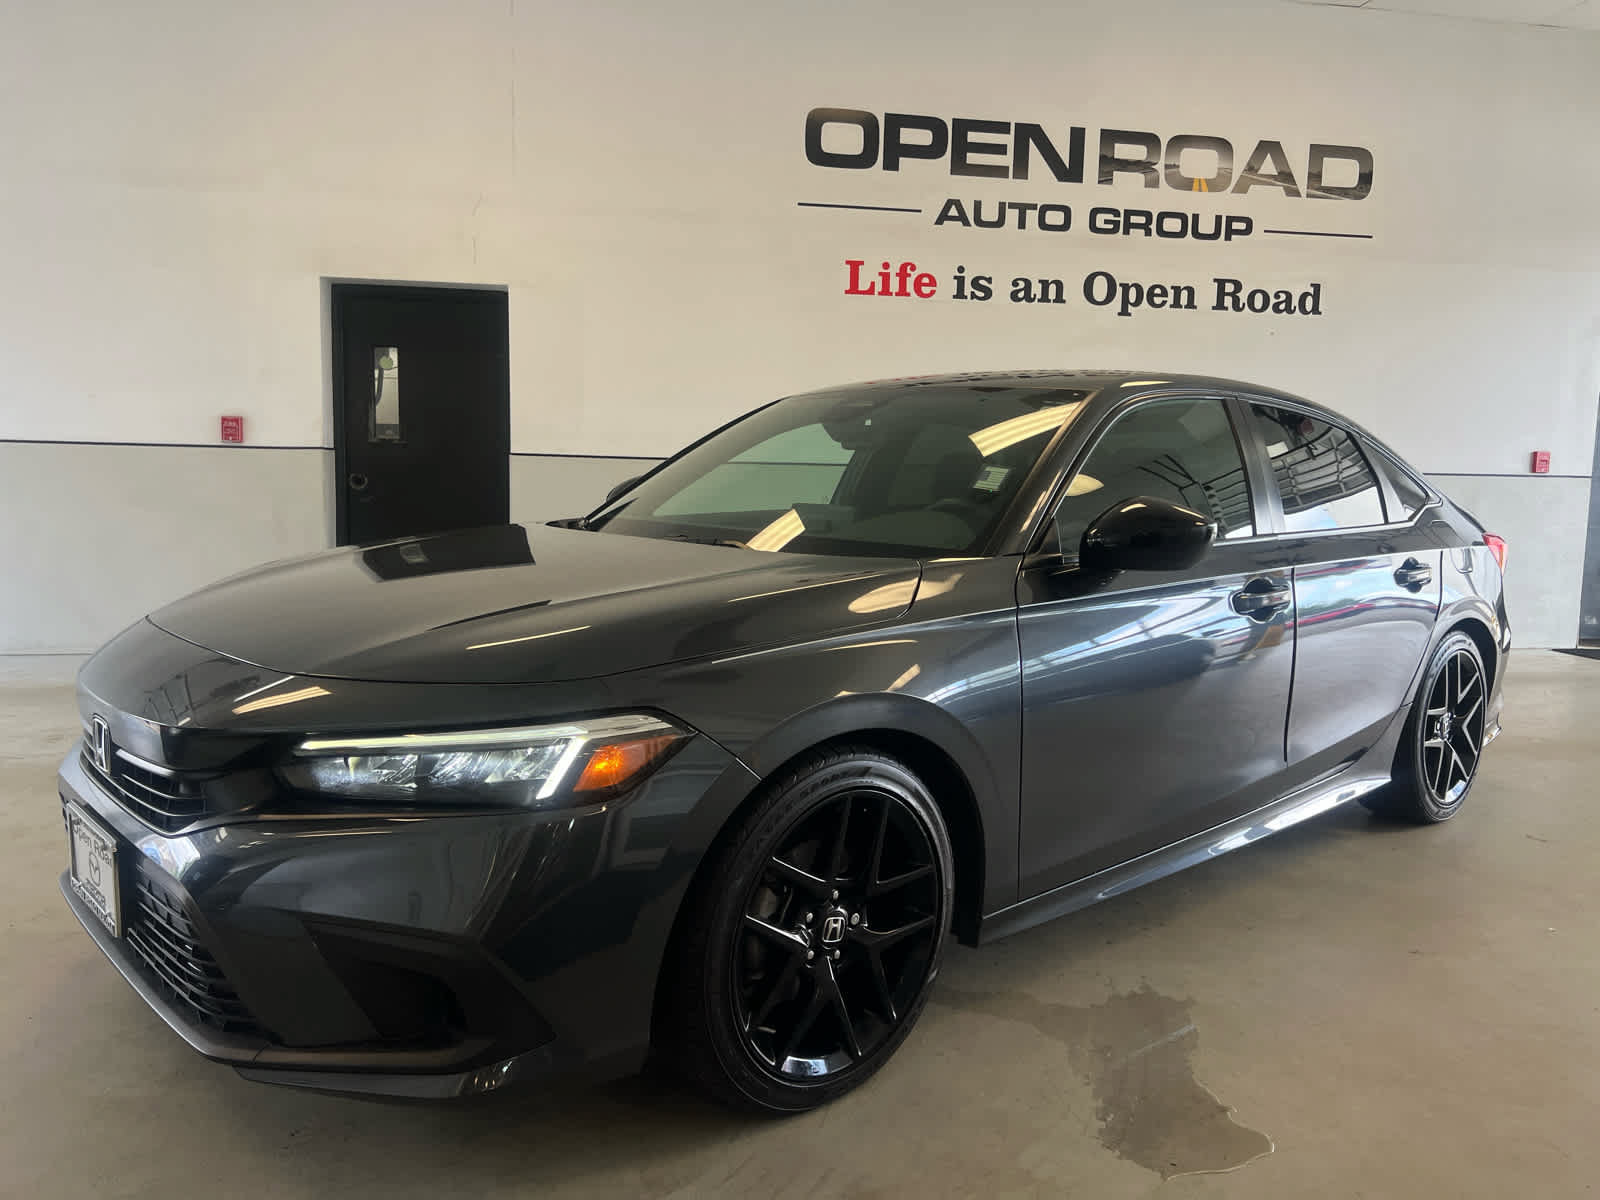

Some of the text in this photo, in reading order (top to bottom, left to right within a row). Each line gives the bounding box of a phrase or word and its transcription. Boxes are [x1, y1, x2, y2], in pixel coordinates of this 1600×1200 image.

[805, 107, 1374, 201] OPEN ROAD
[933, 198, 1254, 242] AUTO GROUP
[844, 260, 1323, 317] Life is an Open Road
